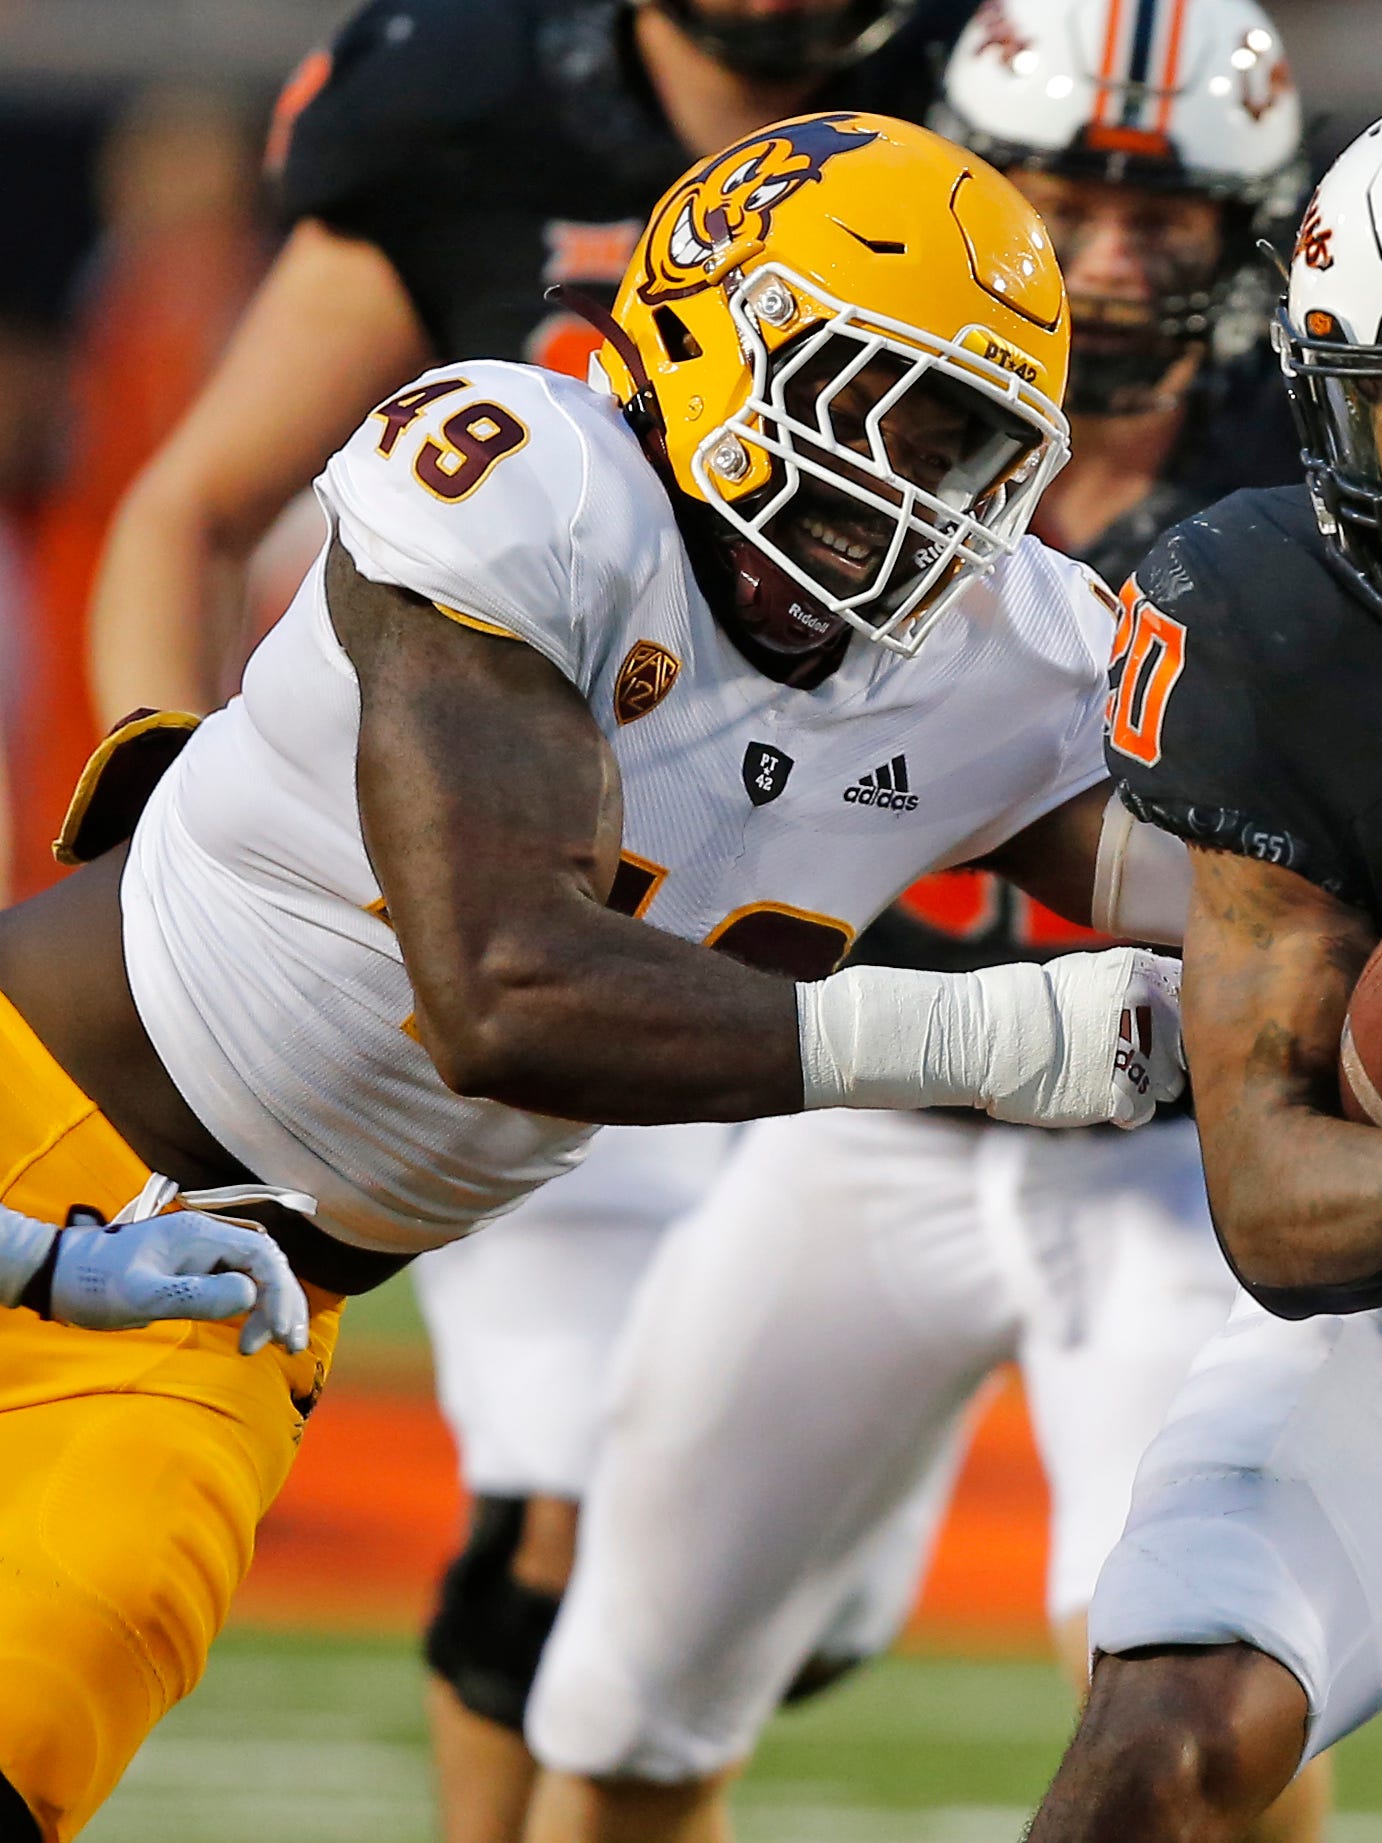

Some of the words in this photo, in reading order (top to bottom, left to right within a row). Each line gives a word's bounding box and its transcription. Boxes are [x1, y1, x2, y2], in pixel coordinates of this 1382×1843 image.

[368, 376, 531, 504] 49
[788, 602, 830, 634] Riddell
[760, 752, 779, 771] PT
[755, 774, 774, 792] 42
[843, 786, 919, 811] adidas
